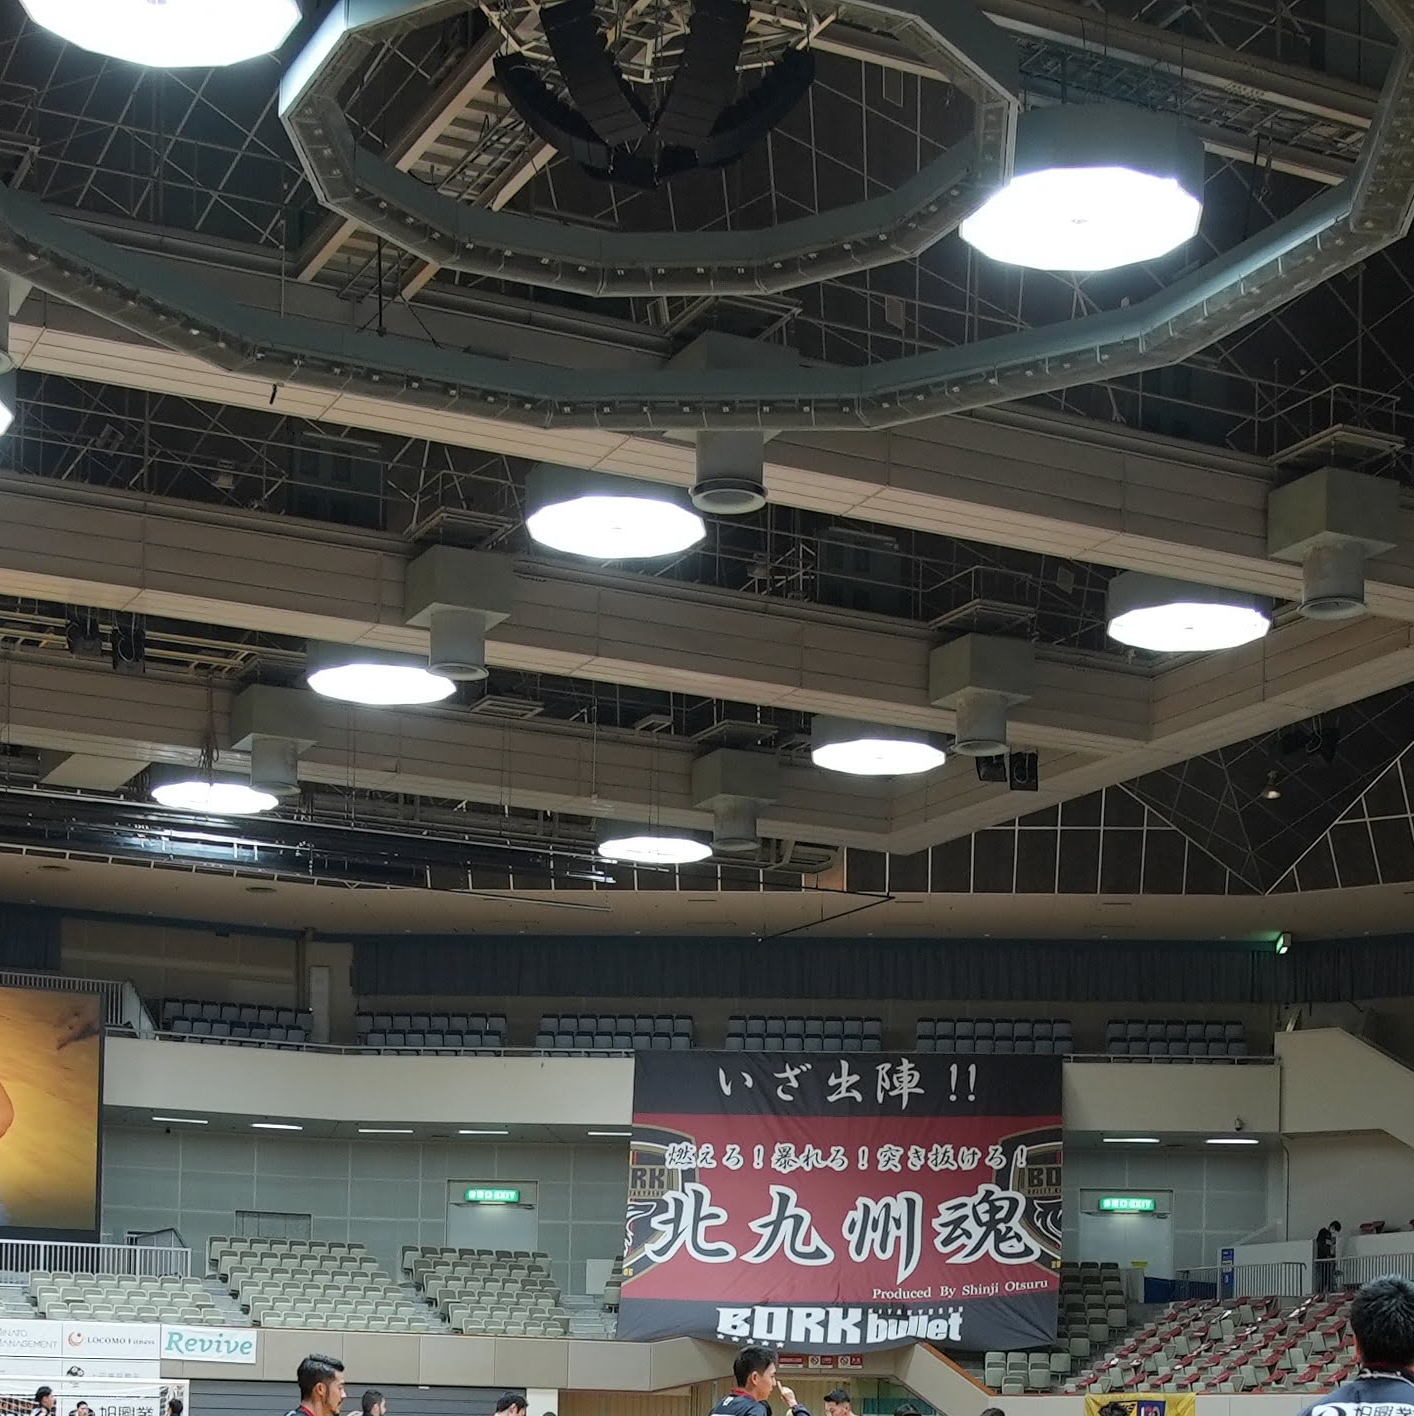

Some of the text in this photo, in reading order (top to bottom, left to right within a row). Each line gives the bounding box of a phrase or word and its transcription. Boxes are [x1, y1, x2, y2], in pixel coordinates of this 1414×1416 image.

[645, 1183, 1042, 1285] 北九州魂
[872, 1278, 1049, 1301] Produced By Shinji Otsuru
[715, 1305, 964, 1344] BORK bullet
[87, 1336, 155, 1345] LOCOMO Fitness
[164, 1331, 253, 1355] Revive
